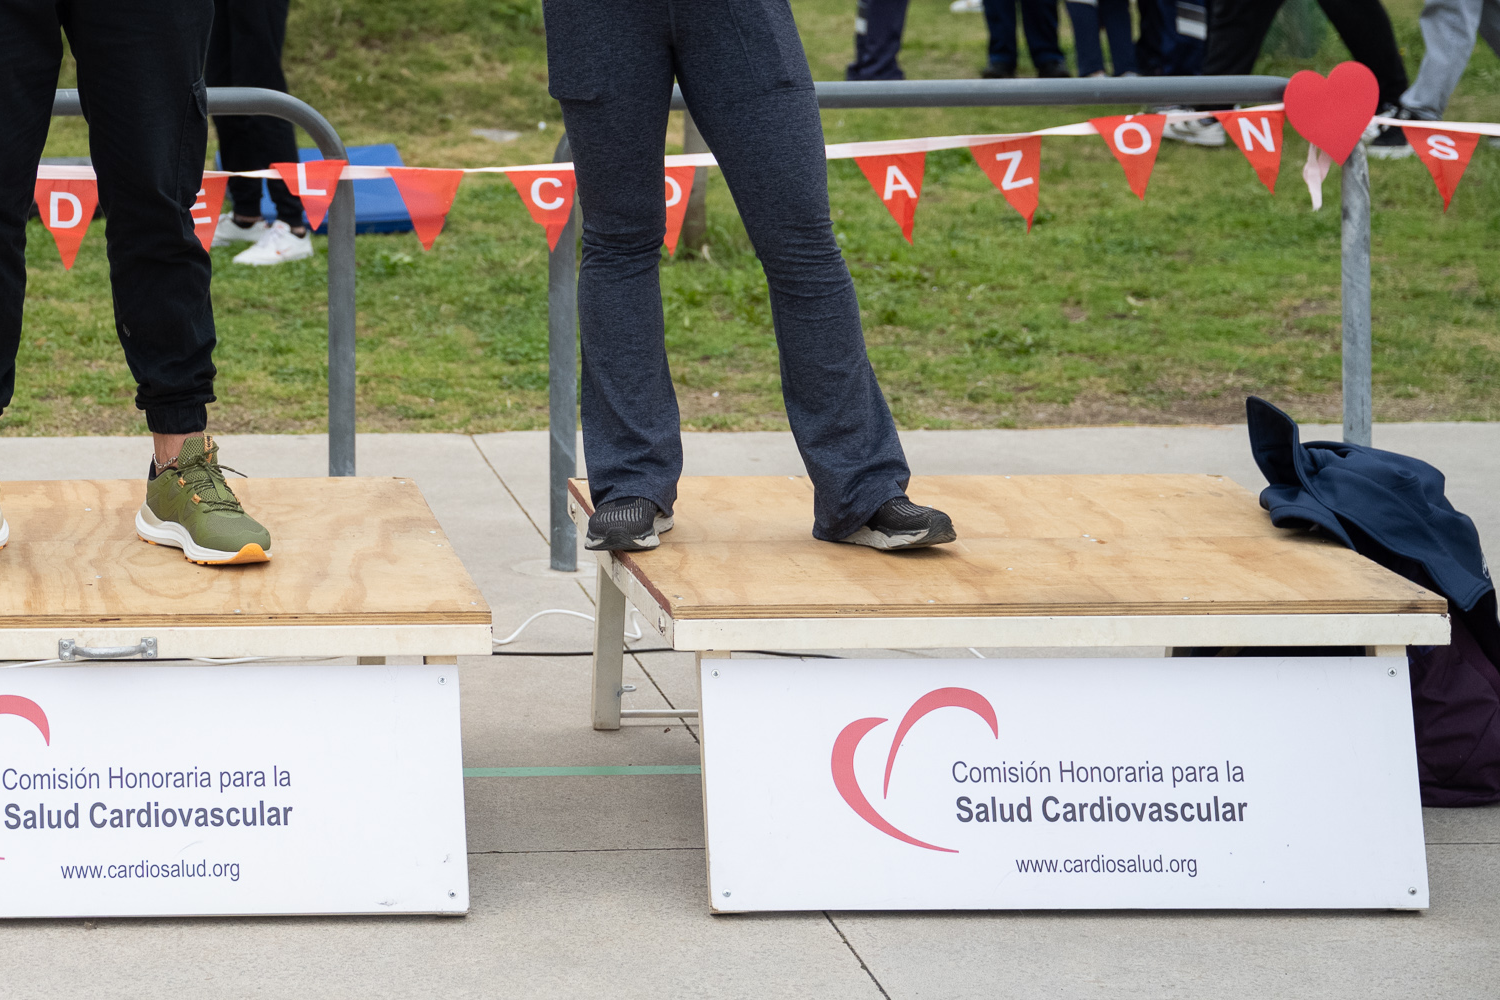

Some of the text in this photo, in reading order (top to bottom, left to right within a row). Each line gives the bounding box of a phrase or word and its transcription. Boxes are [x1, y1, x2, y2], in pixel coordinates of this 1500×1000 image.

[3, 765, 291, 793] Comisión Honoraria para la
[952, 760, 1244, 788] Comisión Honoraria para la
[4, 800, 293, 829] Salud Cardiovascular
[957, 796, 1247, 822] Salud Cardiovascular
[61, 859, 240, 882] www.cardiosalud.org
[1017, 855, 1197, 877] www.cardiosalud.org
